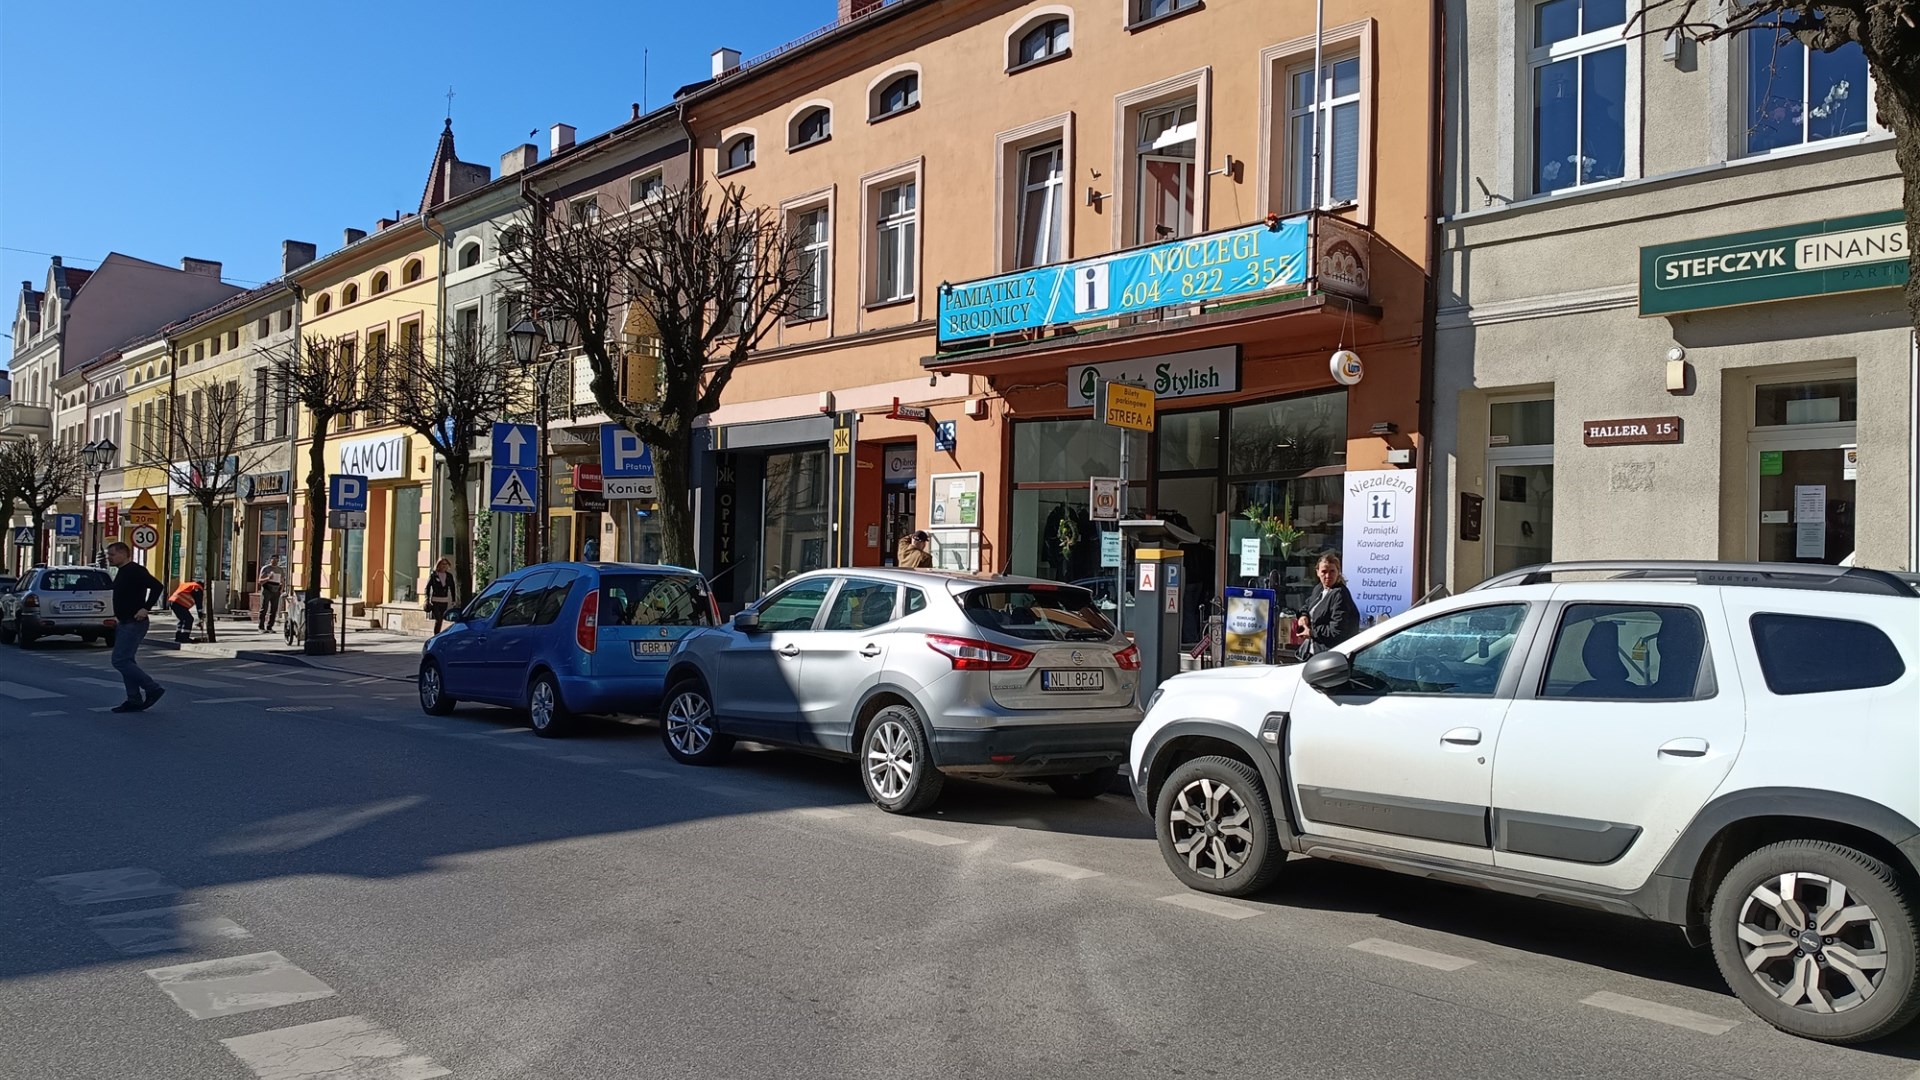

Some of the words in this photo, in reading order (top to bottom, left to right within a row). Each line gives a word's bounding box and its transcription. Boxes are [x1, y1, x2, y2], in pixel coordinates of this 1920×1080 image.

[1149, 231, 1261, 277] NOCLEGI
[1665, 246, 1787, 281] STEFCZYK
[1803, 232, 1910, 264] FINANS
[1842, 264, 1906, 281] PARTN
[1121, 279, 1161, 308] 604
[1181, 268, 1223, 297] 822
[1247, 254, 1292, 287] 355
[945, 278, 1021, 311] PAMIĄTKI
[1026, 277, 1035, 297] Z
[950, 303, 1030, 333] BRODNICY
[1154, 363, 1219, 395] Stylish
[1124, 388, 1139, 398] Bilety
[1115, 398, 1147, 408] parkingowe
[899, 407, 924, 417] Szewc
[1109, 408, 1143, 425] STREFA
[1146, 414, 1153, 427] A
[936, 422, 955, 440] 13
[1590, 425, 1648, 438] HALLERA
[1656, 423, 1671, 434] 15
[613, 430, 644, 470] P
[625, 463, 652, 472] Płatny
[338, 479, 360, 506] P
[1349, 474, 1414, 498] Niezależna
[1371, 495, 1391, 518] it
[61, 516, 76, 532] P
[720, 494, 732, 563] OPTYK
[1363, 526, 1398, 536] Pamiątki
[136, 531, 155, 544] 30
[1356, 539, 1404, 548] Kawiarenka
[1369, 552, 1390, 561] Desa
[1168, 565, 1177, 583] P
[1356, 565, 1399, 575] Kosmetyki
[1142, 574, 1152, 588] A
[1361, 578, 1397, 588] biżuteria
[1168, 597, 1175, 609] A
[1362, 592, 1402, 601] bursztynu
[1365, 605, 1393, 614] LOTTO
[641, 641, 660, 653] CBR
[1051, 672, 1069, 686] NLI
[1075, 672, 1099, 686] 8P61
